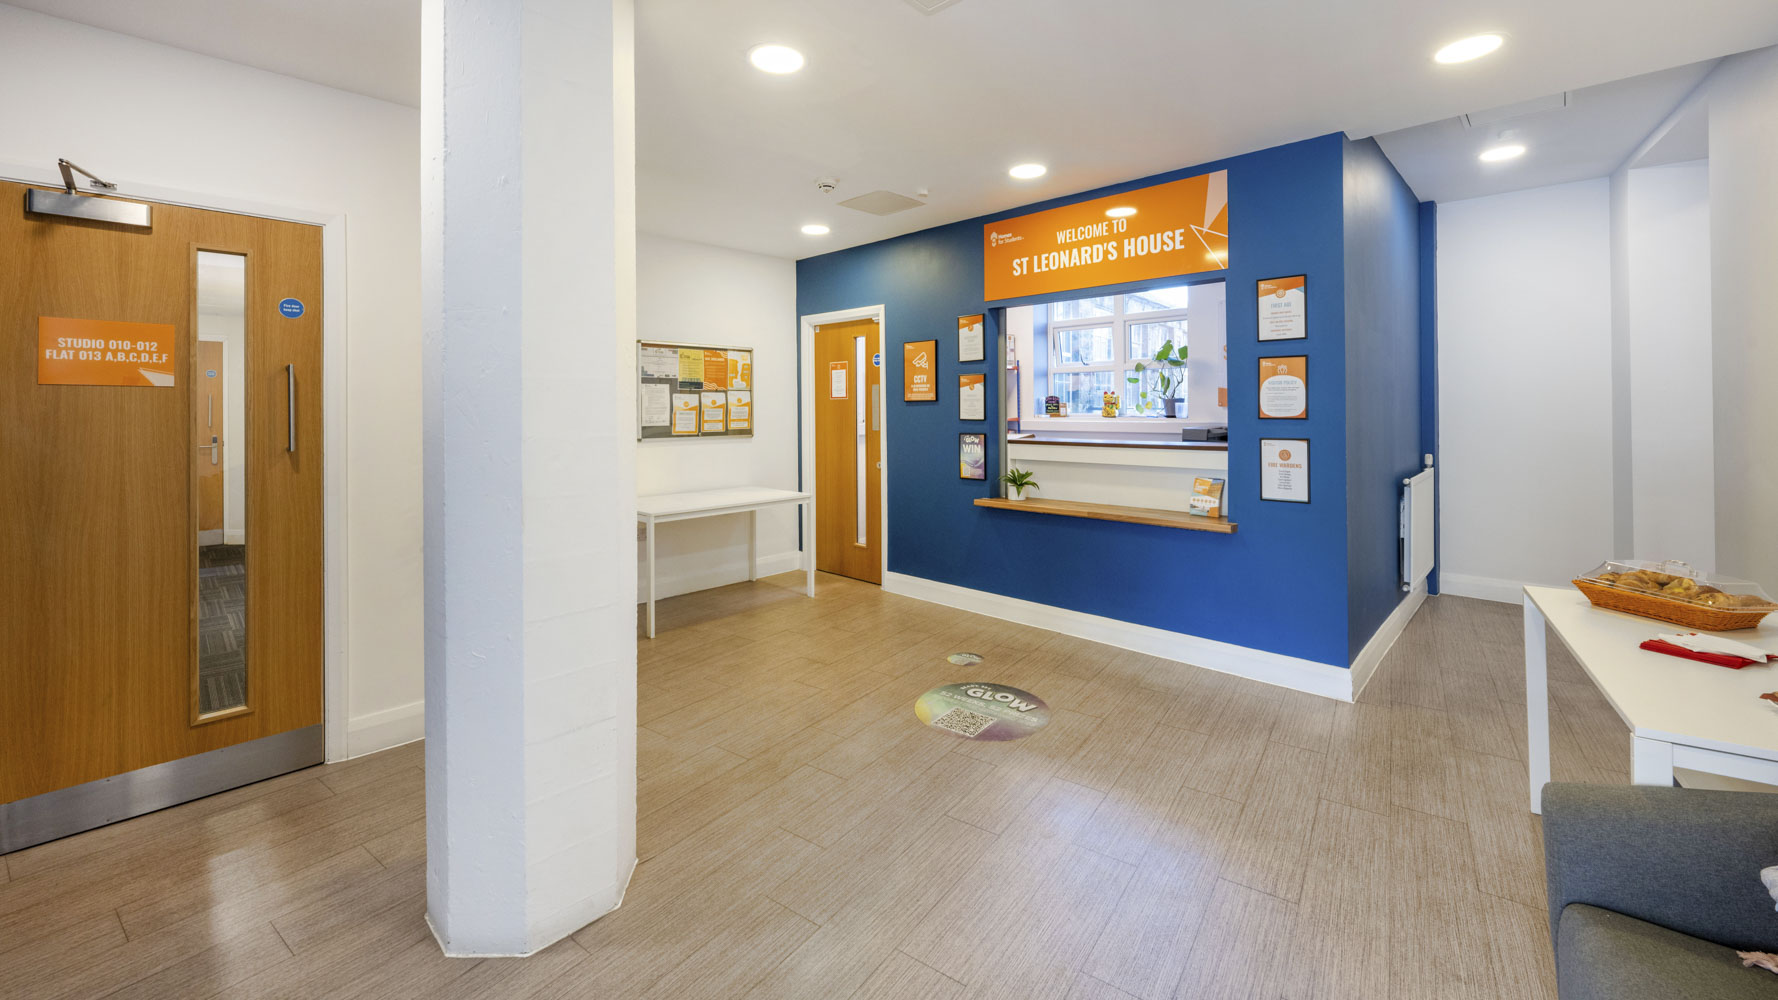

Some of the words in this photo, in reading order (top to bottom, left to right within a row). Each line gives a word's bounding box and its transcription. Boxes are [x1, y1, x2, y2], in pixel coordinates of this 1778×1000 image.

[1056, 221, 1109, 245] WELCOME
[1112, 218, 1127, 233] TO
[1012, 257, 1028, 277] ST
[1033, 241, 1118, 273] LEONARD'S
[1123, 228, 1185, 259] HOUSE
[57, 337, 105, 349] STUDIO
[109, 338, 158, 351] 010-012
[45, 349, 75, 360] FLAT
[79, 350, 102, 361] 013
[105, 351, 169, 364] A,B,C,D,E,F
[913, 375, 927, 383] CCTV
[962, 444, 981, 453] WIN
[966, 688, 1038, 712] GLOW
